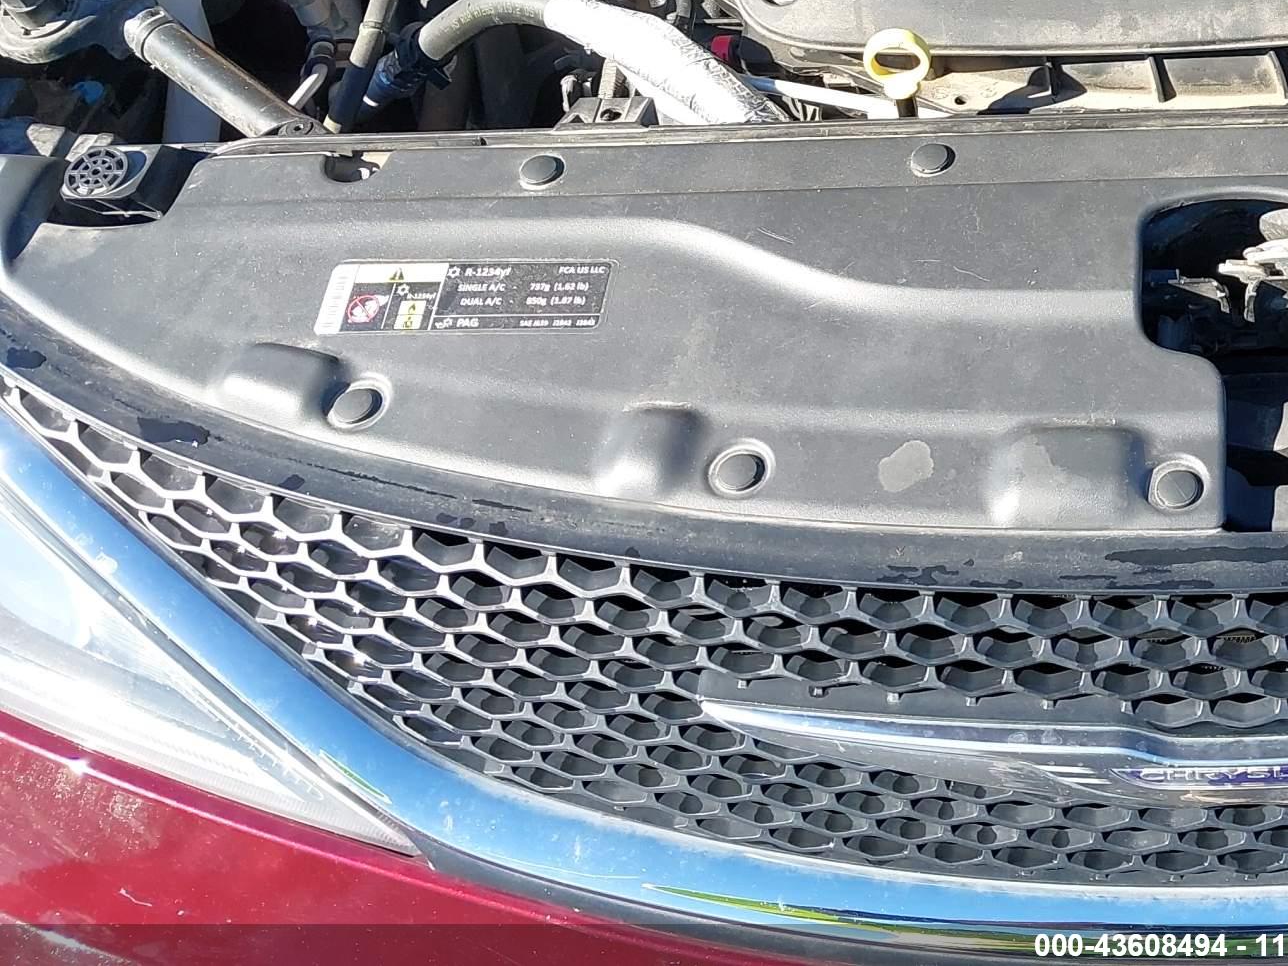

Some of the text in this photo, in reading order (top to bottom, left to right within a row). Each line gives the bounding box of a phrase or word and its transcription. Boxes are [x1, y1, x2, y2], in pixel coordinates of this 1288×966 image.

[464, 267, 512, 280] R-1234yf
[558, 266, 606, 274] FCA US LLC
[457, 283, 487, 292] SINGLE
[488, 283, 506, 292] A/C
[460, 298, 483, 306] DUAL
[484, 297, 503, 306] A/C
[456, 318, 479, 327] PAG
